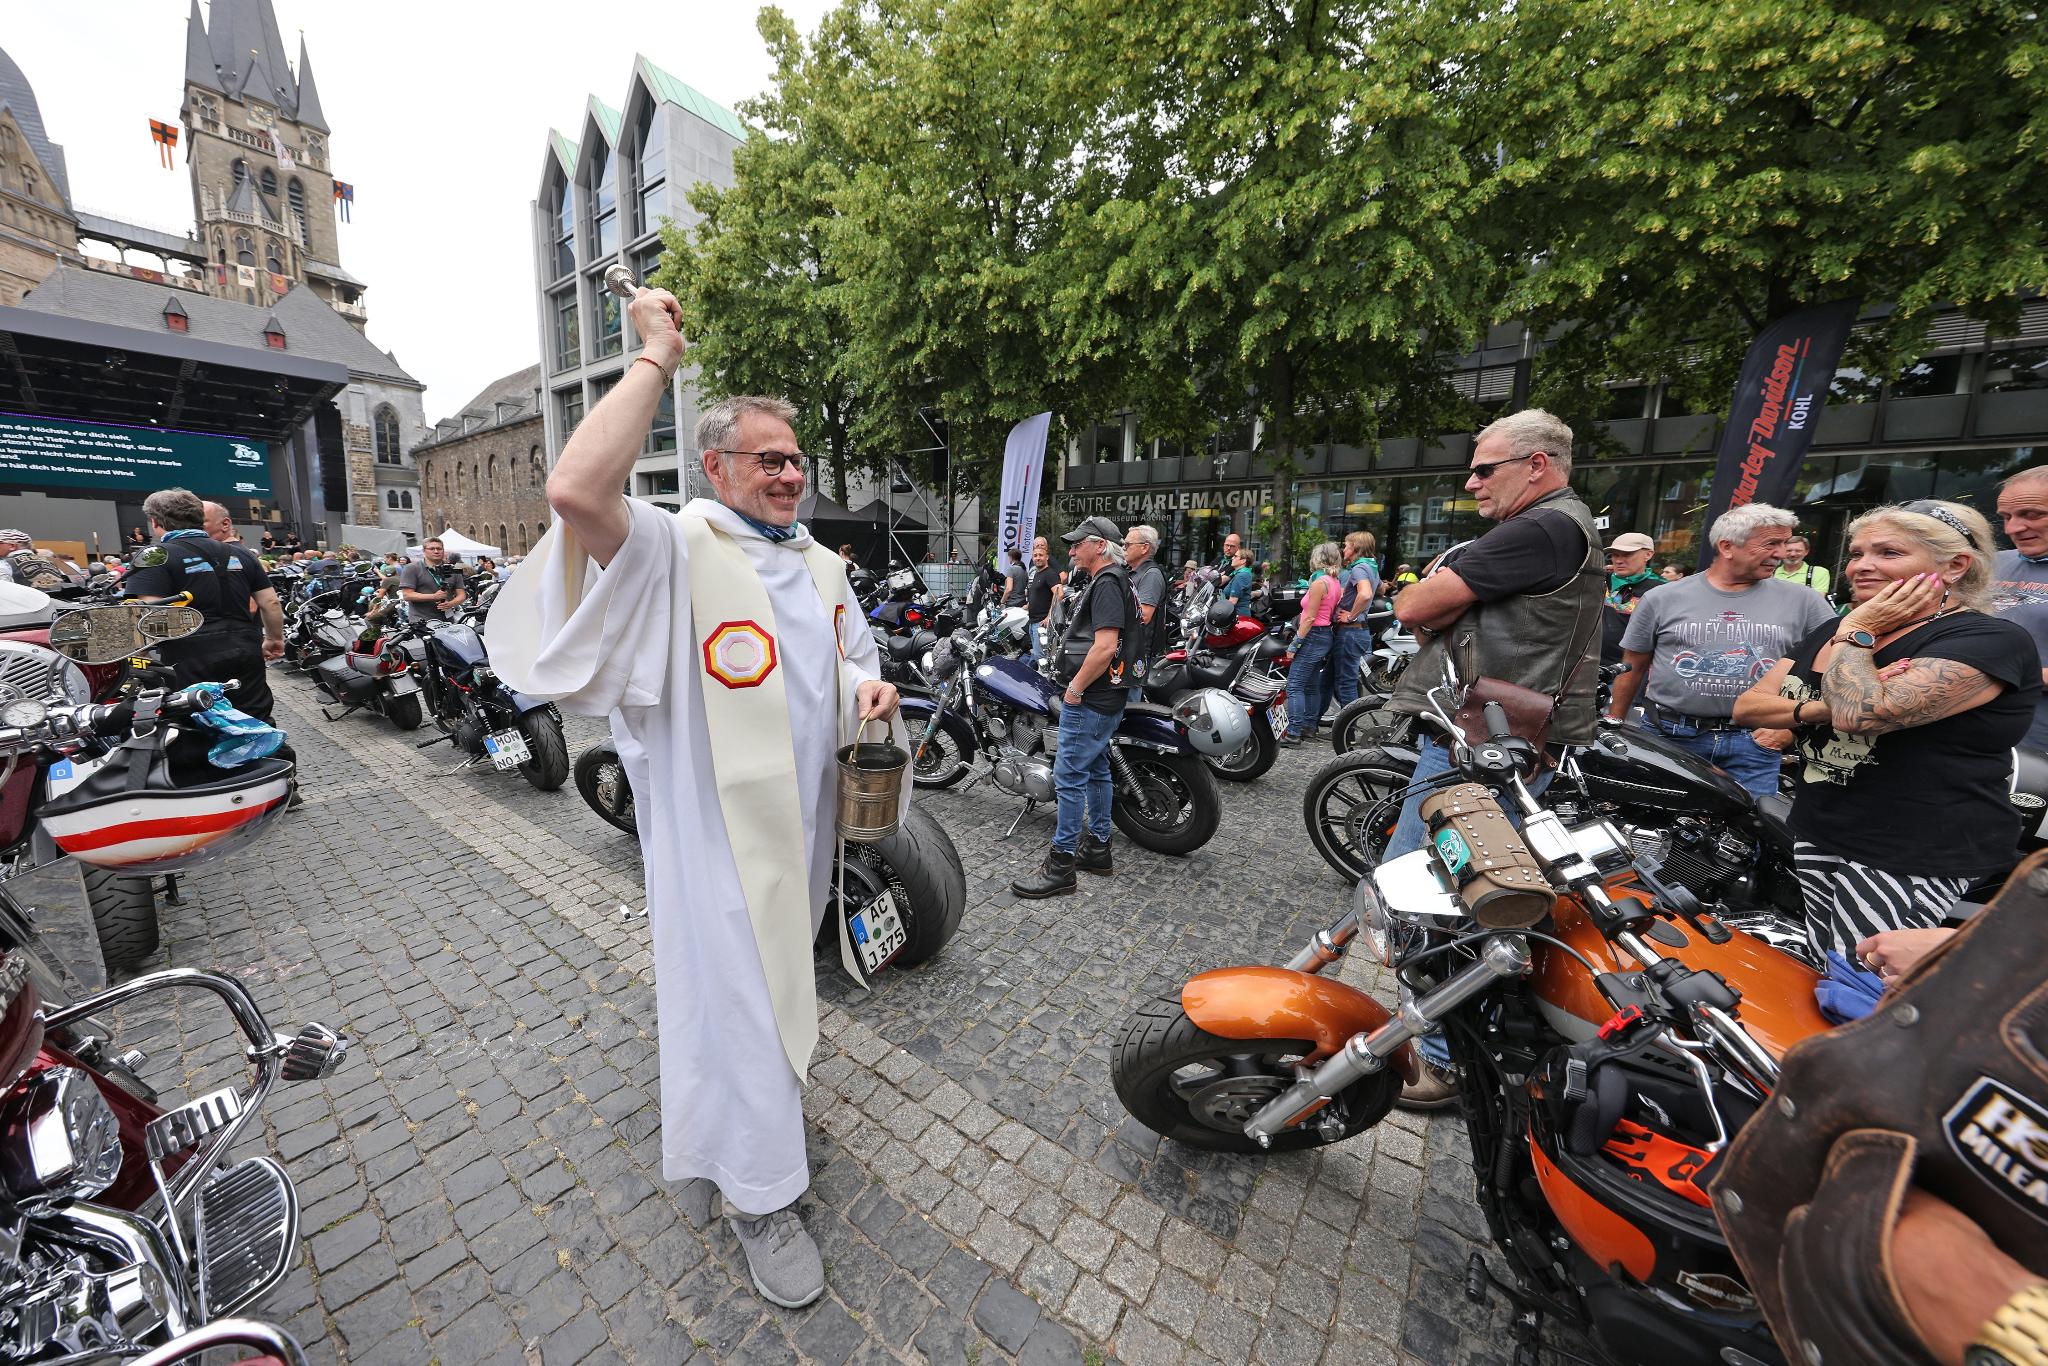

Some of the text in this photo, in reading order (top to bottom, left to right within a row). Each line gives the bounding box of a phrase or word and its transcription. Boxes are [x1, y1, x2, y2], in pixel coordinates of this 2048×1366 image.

[1728, 338, 1800, 510] Harley-Davidson
[1788, 394, 1813, 430] KOHL
[1060, 489, 1272, 513] CENTRE CHARLEMAGNE
[1003, 501, 1020, 553] KOHL
[1140, 512, 1172, 522] Aachen
[1022, 517, 1033, 553] Motorrad
[1674, 621, 1788, 653] HARLEY-DAVIDSON
[495, 732, 519, 746] MON
[497, 750, 530, 769] NO 13
[56, 769, 66, 777] D
[2011, 795, 2042, 805] PREMIER
[870, 898, 887, 922] AC
[868, 927, 903, 970] J 375
